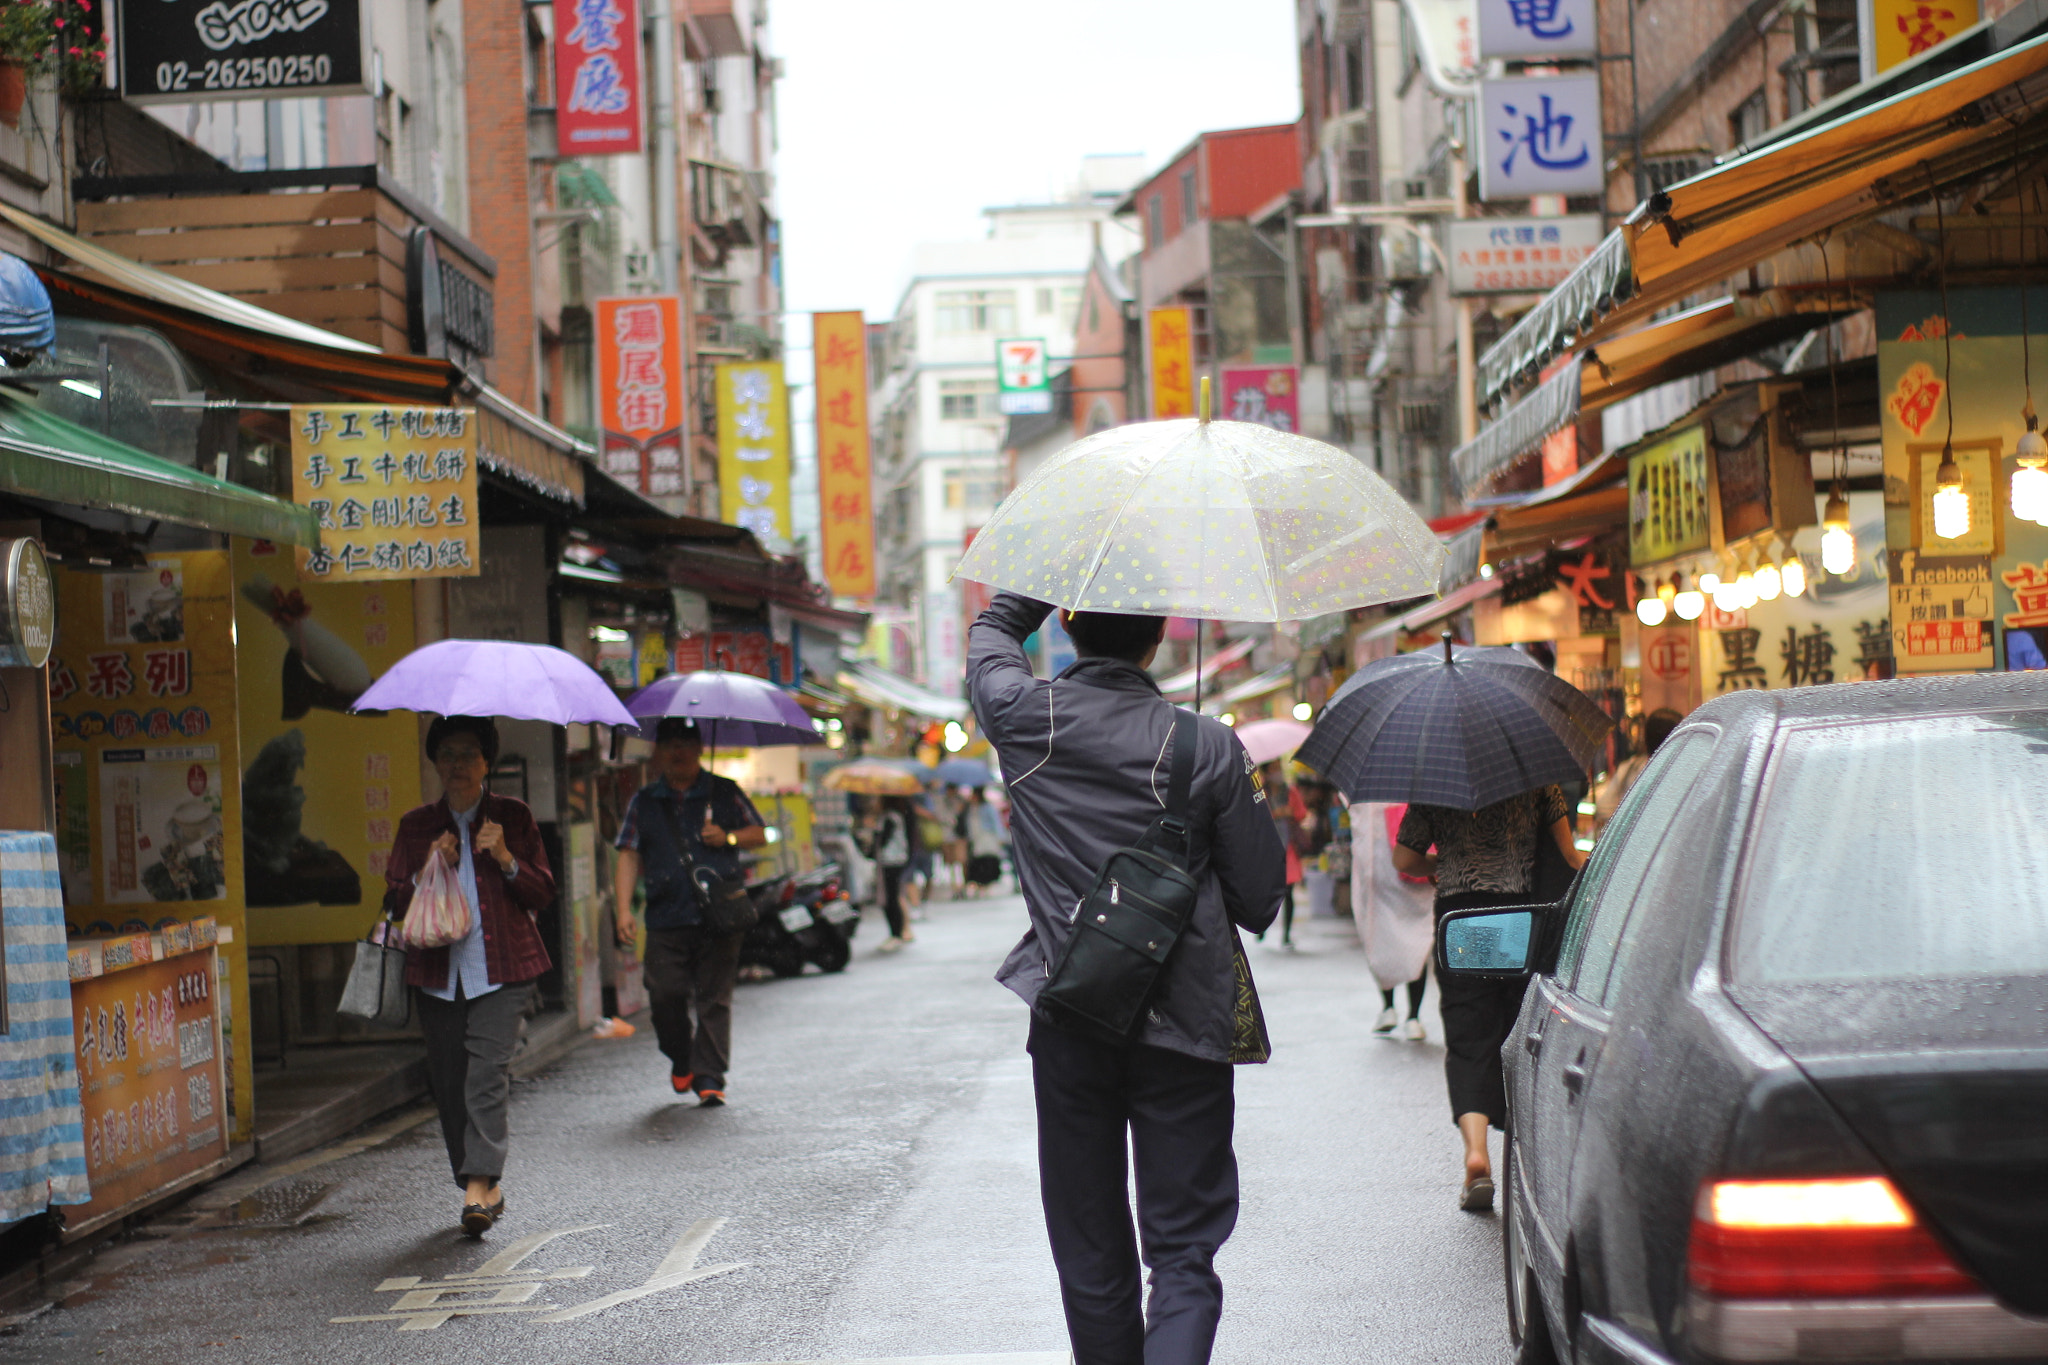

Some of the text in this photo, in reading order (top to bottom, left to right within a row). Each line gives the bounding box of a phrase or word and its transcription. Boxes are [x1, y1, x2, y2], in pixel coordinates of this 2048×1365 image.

[157, 54, 332, 92] 02-26250250
[303, 409, 467, 445] 手工牛軋糖
[304, 449, 466, 488] 手工牛軋餅
[1899, 551, 1991, 585] facebook
[1897, 588, 1932, 604] 打卡
